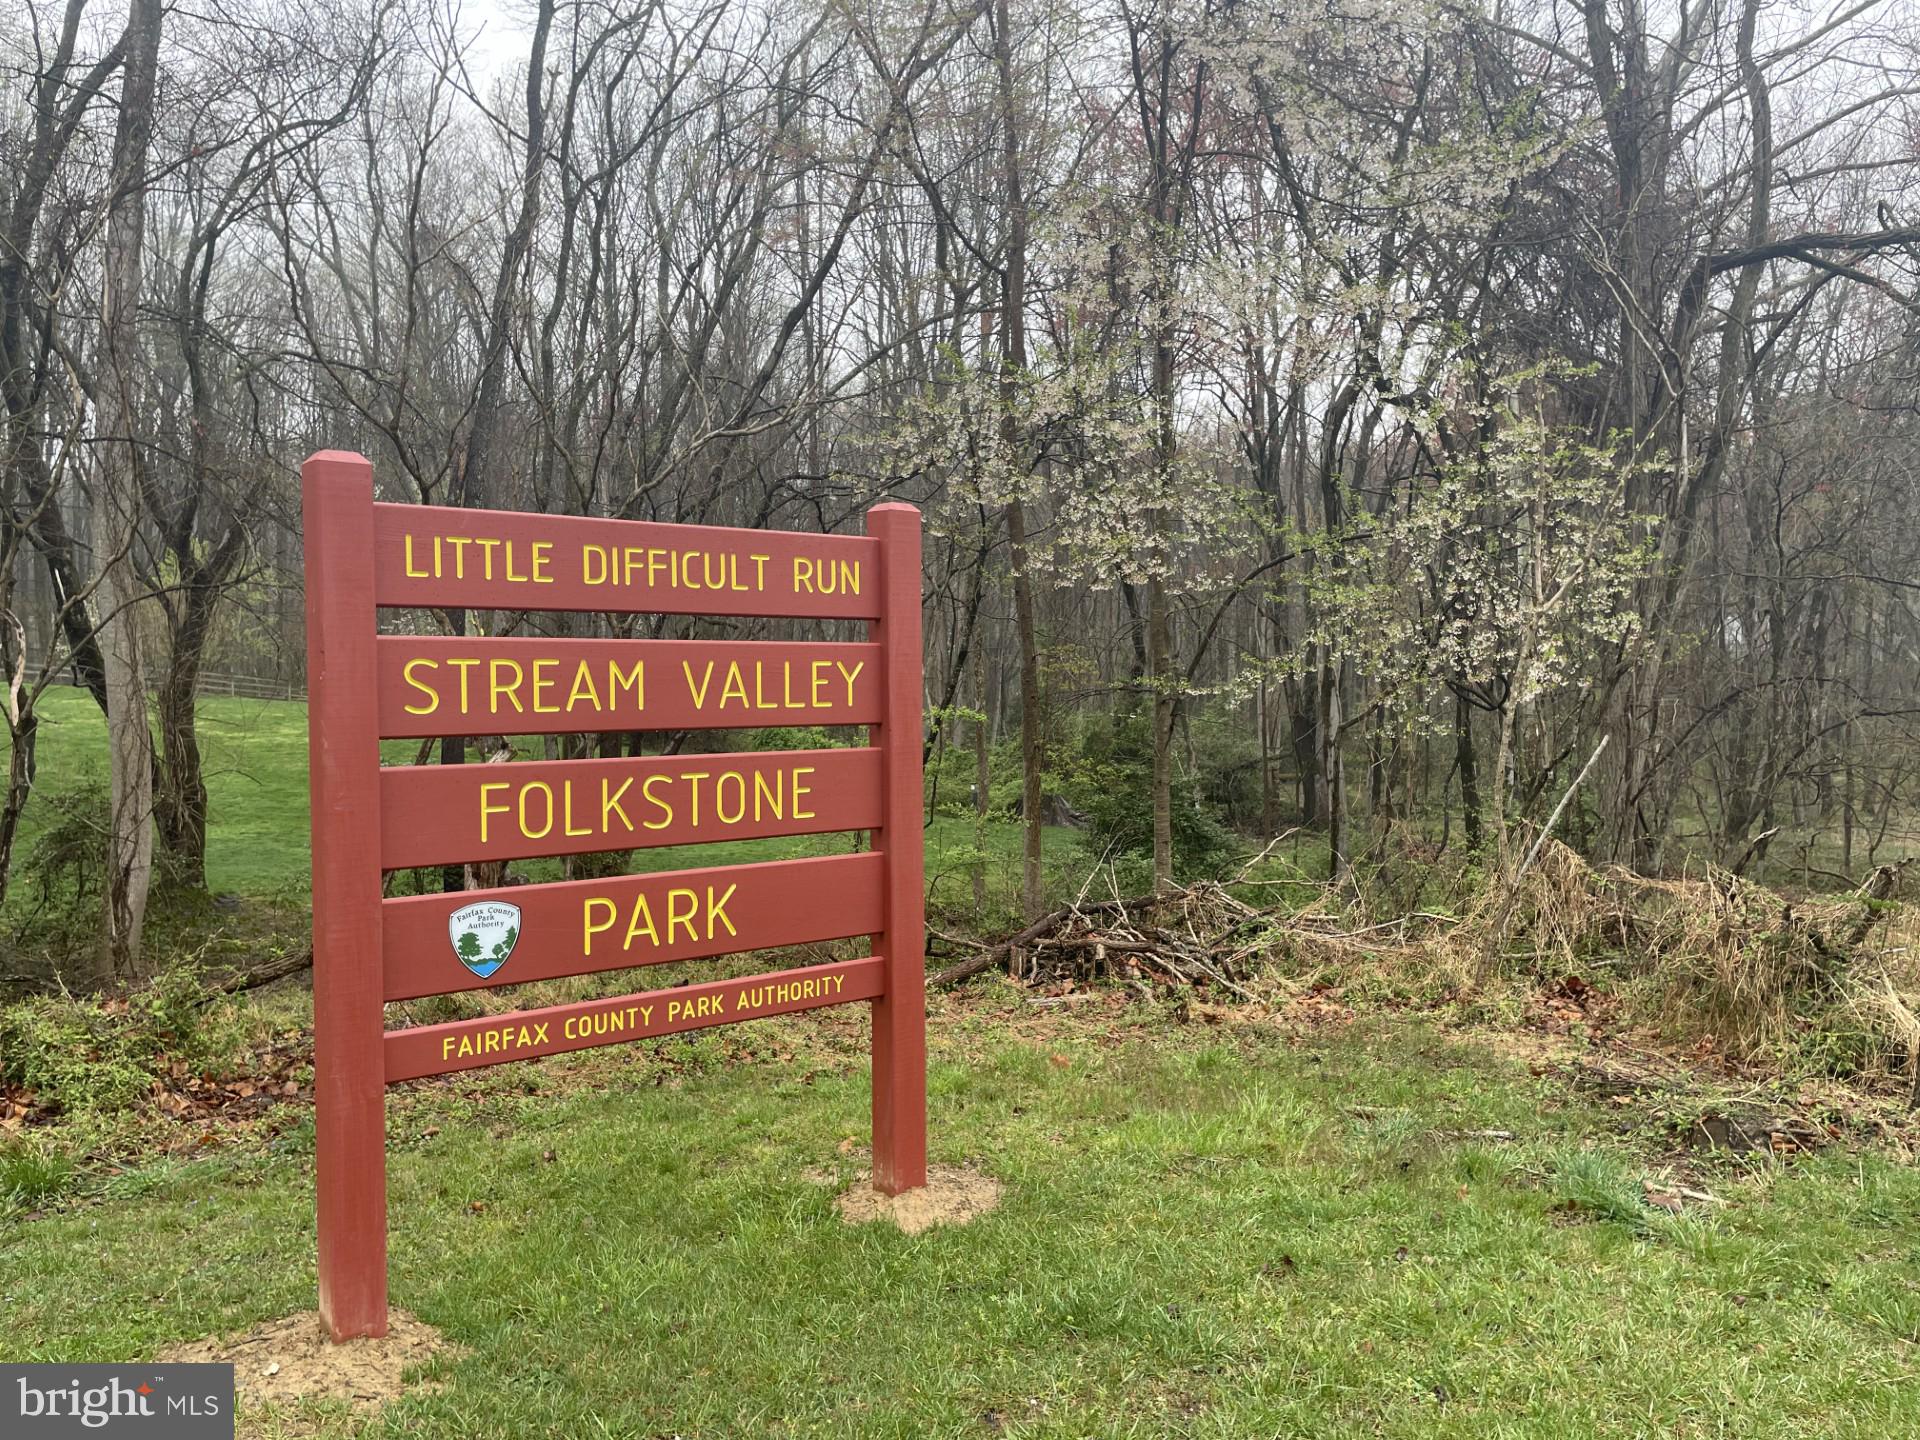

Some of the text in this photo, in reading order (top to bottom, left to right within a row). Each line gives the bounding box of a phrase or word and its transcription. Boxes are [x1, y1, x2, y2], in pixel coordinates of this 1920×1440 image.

[404, 533, 861, 595] LITTLE DIFFICULT RUN
[403, 658, 864, 715] STREAM VALLEY
[480, 766, 816, 843] FOLKSTONE
[457, 907, 515, 922] Fairfax County
[468, 921, 504, 929] Authority
[583, 883, 737, 956] PARK
[442, 974, 845, 1061] FAIRFAX COUNTY PARK AUTHORITY
